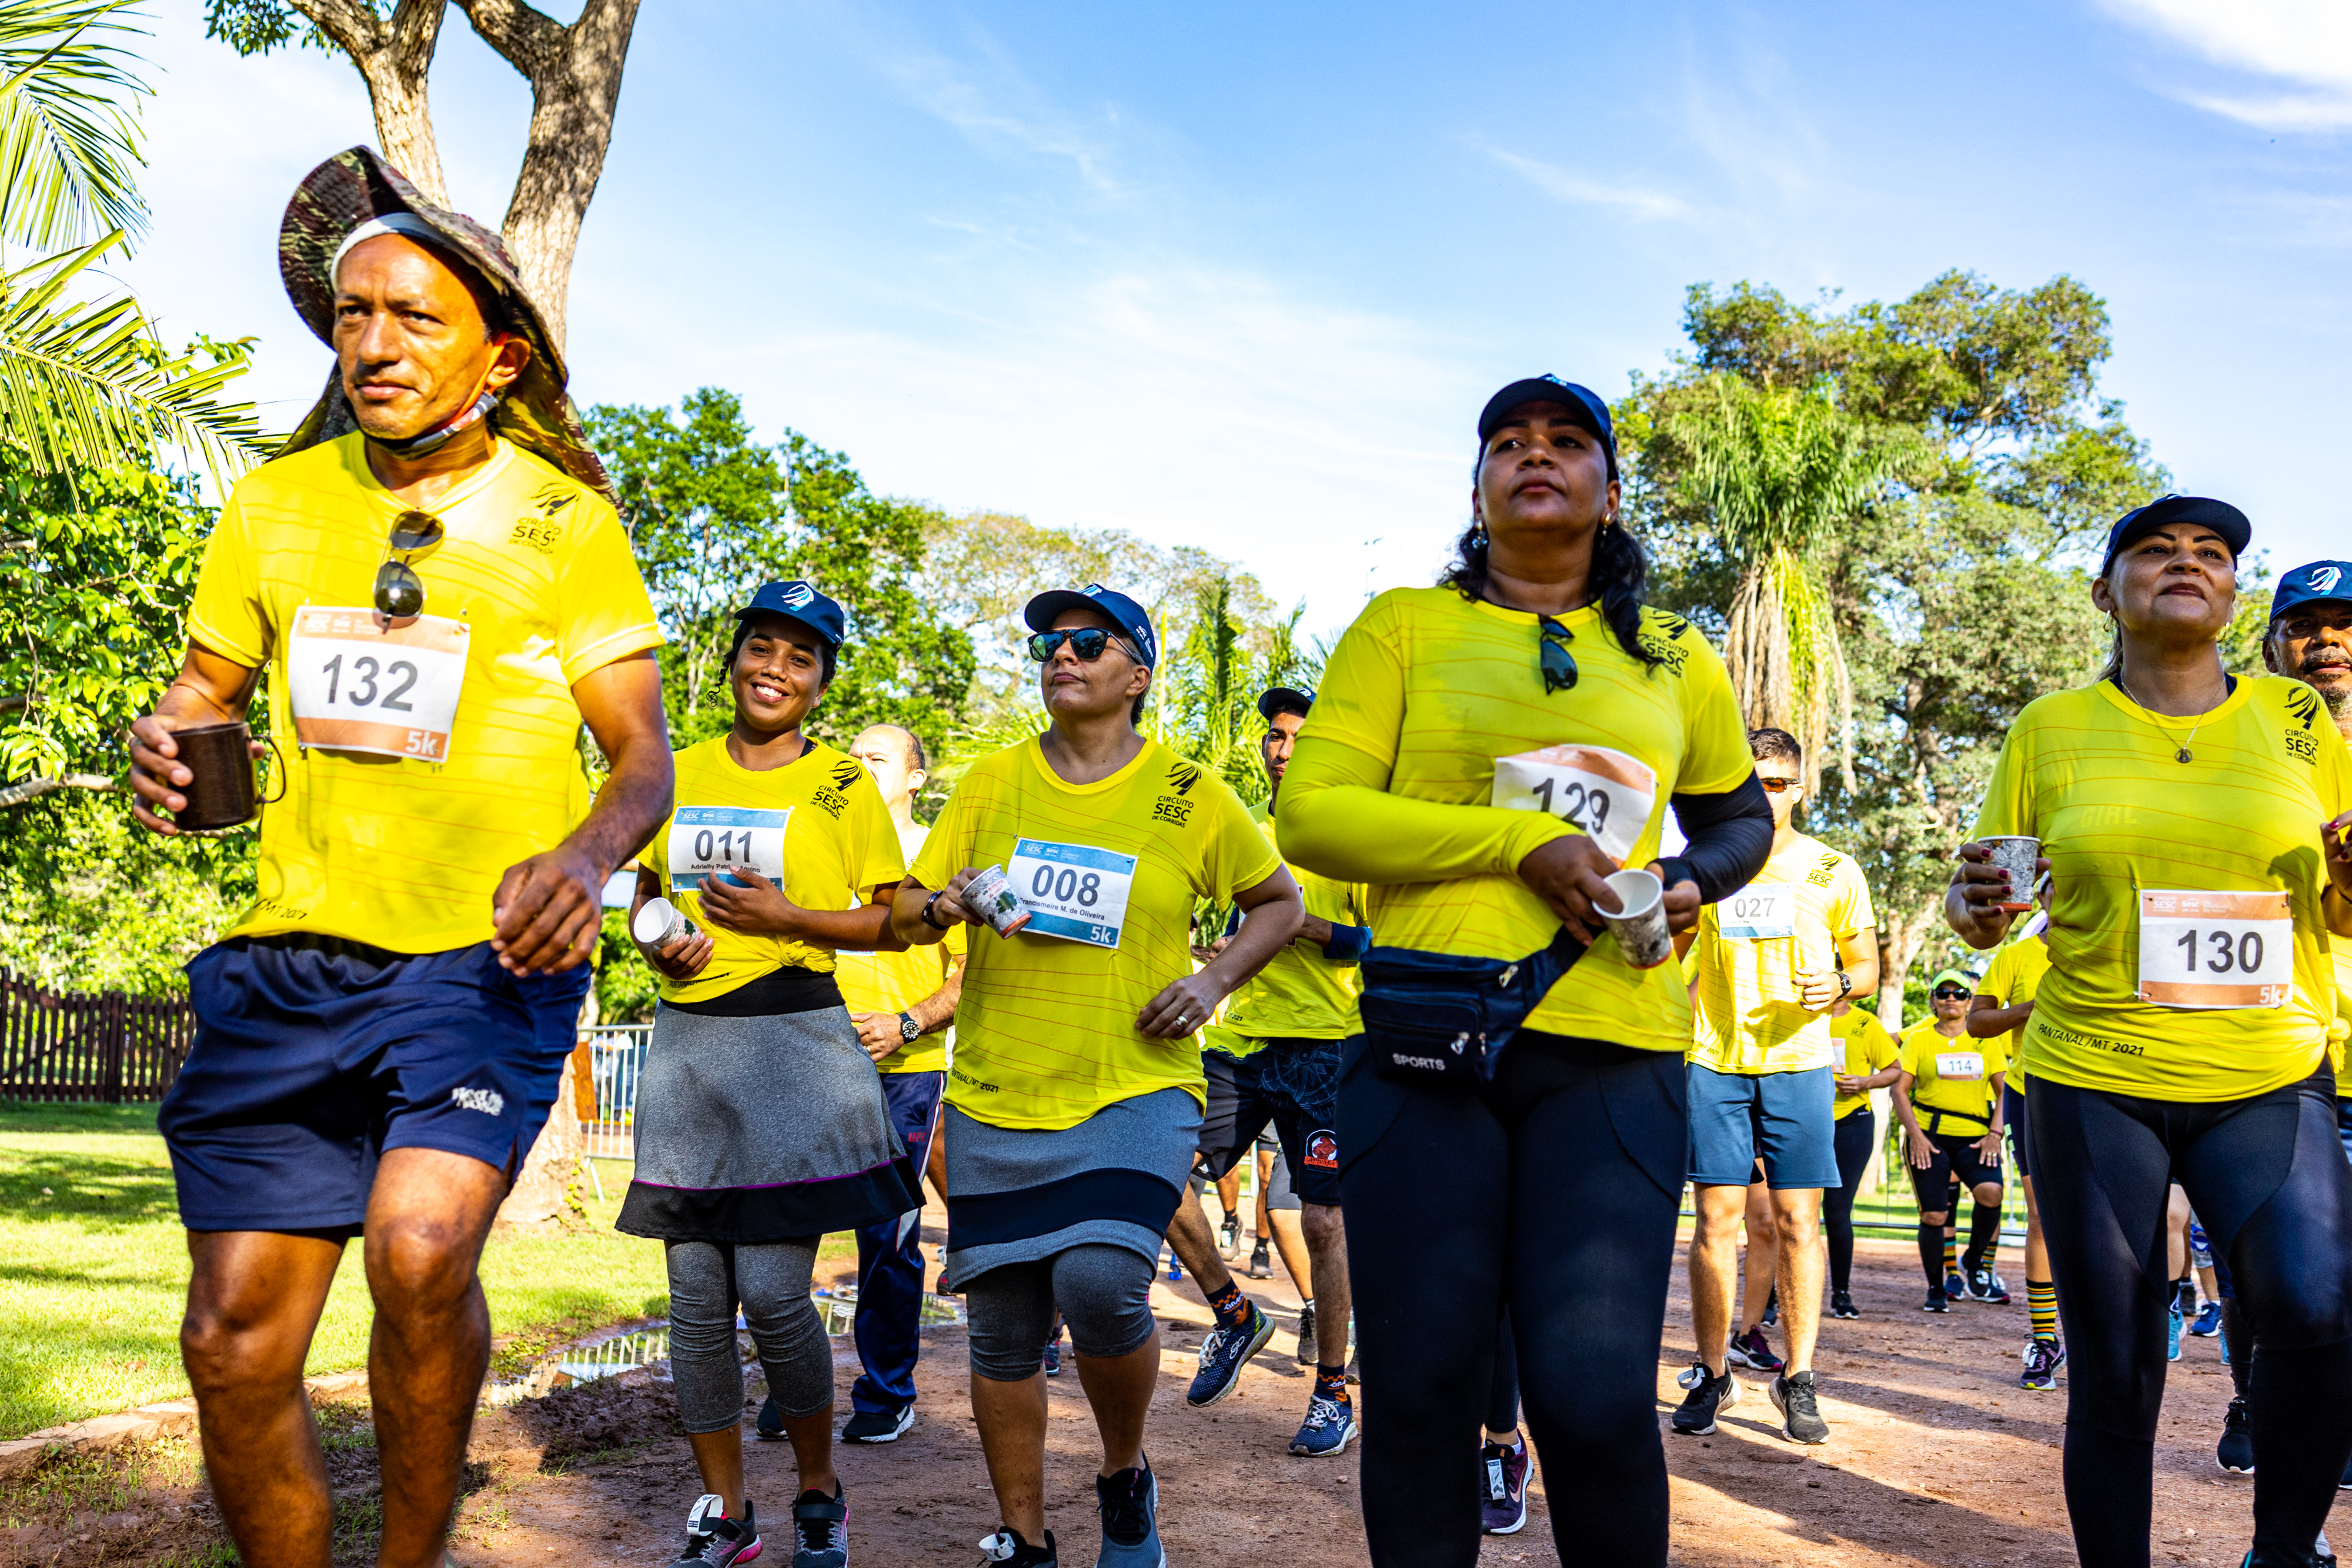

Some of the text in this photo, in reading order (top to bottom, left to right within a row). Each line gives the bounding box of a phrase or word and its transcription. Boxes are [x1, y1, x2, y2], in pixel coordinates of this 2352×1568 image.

[512, 526, 556, 546] SES
[323, 654, 418, 712] 132
[405, 730, 438, 755] 5k
[2285, 729, 2318, 746] CIRCUITO
[2286, 737, 2317, 761] SESC
[813, 791, 845, 816] SESC
[818, 785, 849, 805] CIRCUITO
[1157, 795, 1194, 809] CIRCUITO
[818, 803, 840, 821] CORRIDAS
[1154, 803, 1191, 822] SESC
[1532, 777, 1610, 834] 129
[1160, 815, 1186, 828] CORRIDAS
[694, 830, 753, 863] 011
[1808, 872, 1832, 885] SESC
[1811, 869, 1834, 879] CIRCUITO
[1032, 865, 1101, 907] 008
[1735, 897, 1775, 918] 027
[2153, 900, 2176, 909] SESC
[1080, 909, 1105, 921] Oliveira
[1090, 925, 1112, 944] 5k
[2178, 930, 2263, 974] 130
[2259, 985, 2282, 1004] 5k
[2112, 1042, 2145, 1057] 2021
[1392, 1052, 1446, 1071] SPORTS
[1949, 1059, 1973, 1072] 114
[979, 1082, 999, 1094] 2021
[908, 1132, 927, 1142] UFC
